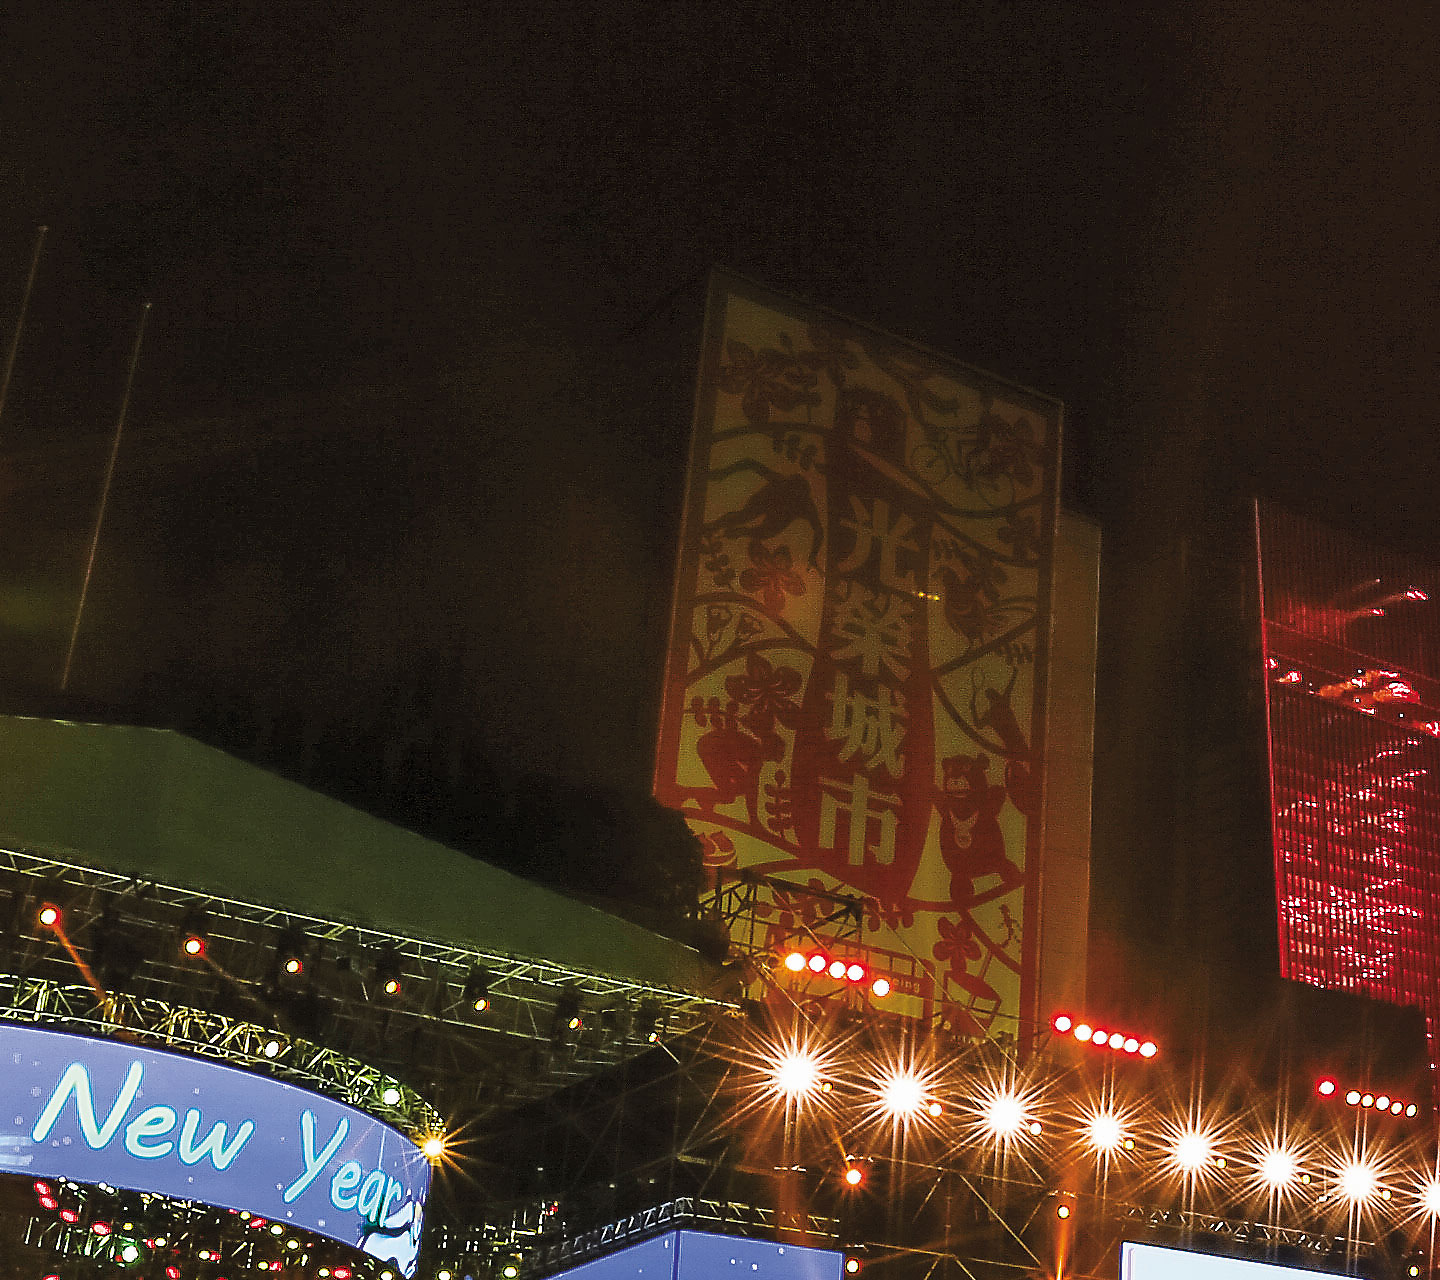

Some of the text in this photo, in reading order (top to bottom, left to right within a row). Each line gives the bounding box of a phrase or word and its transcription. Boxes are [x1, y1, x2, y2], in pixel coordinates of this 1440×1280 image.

[819, 497, 919, 867] 光榮城市
[30, 1059, 253, 1173] New
[283, 1109, 403, 1228] Year
